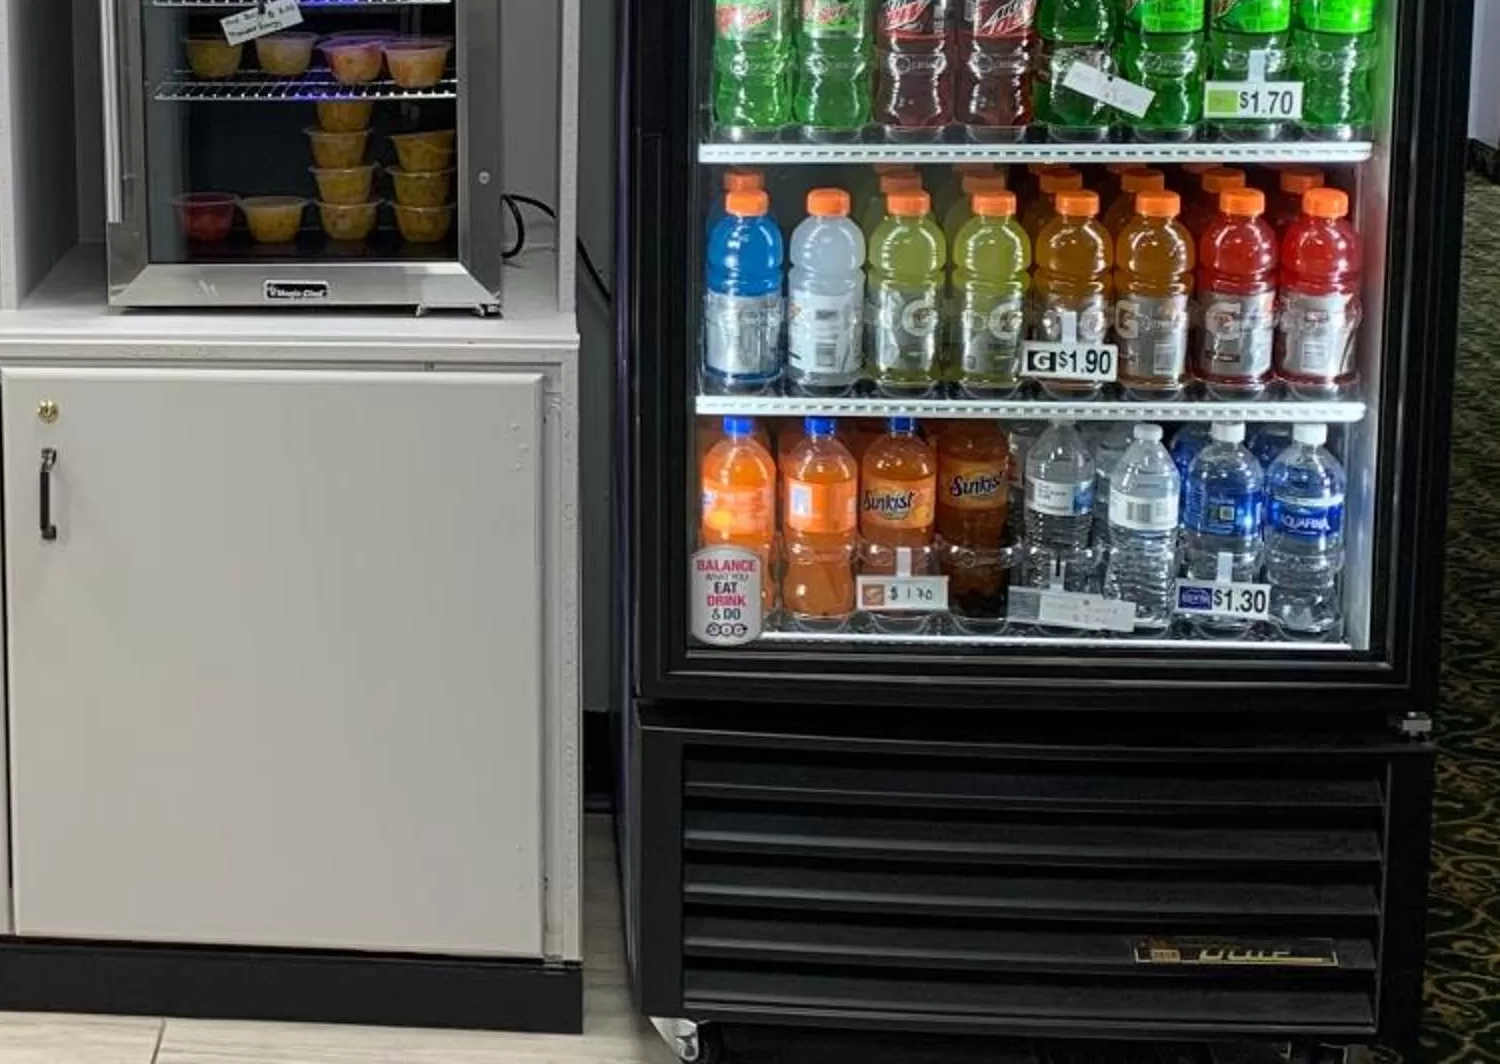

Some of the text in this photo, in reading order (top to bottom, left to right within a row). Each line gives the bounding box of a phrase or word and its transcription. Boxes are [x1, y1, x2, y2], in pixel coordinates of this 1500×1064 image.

[1239, 90, 1293, 116] $1.70
[1059, 349, 1112, 375] $1.90
[949, 471, 1005, 497] Sunkist
[862, 489, 917, 513] Sunkist
[696, 559, 757, 572] BALANCE
[714, 581, 738, 594] EAT
[707, 595, 747, 607] DRINK
[1213, 589, 1267, 614] $1.30
[711, 608, 741, 620] & DO
